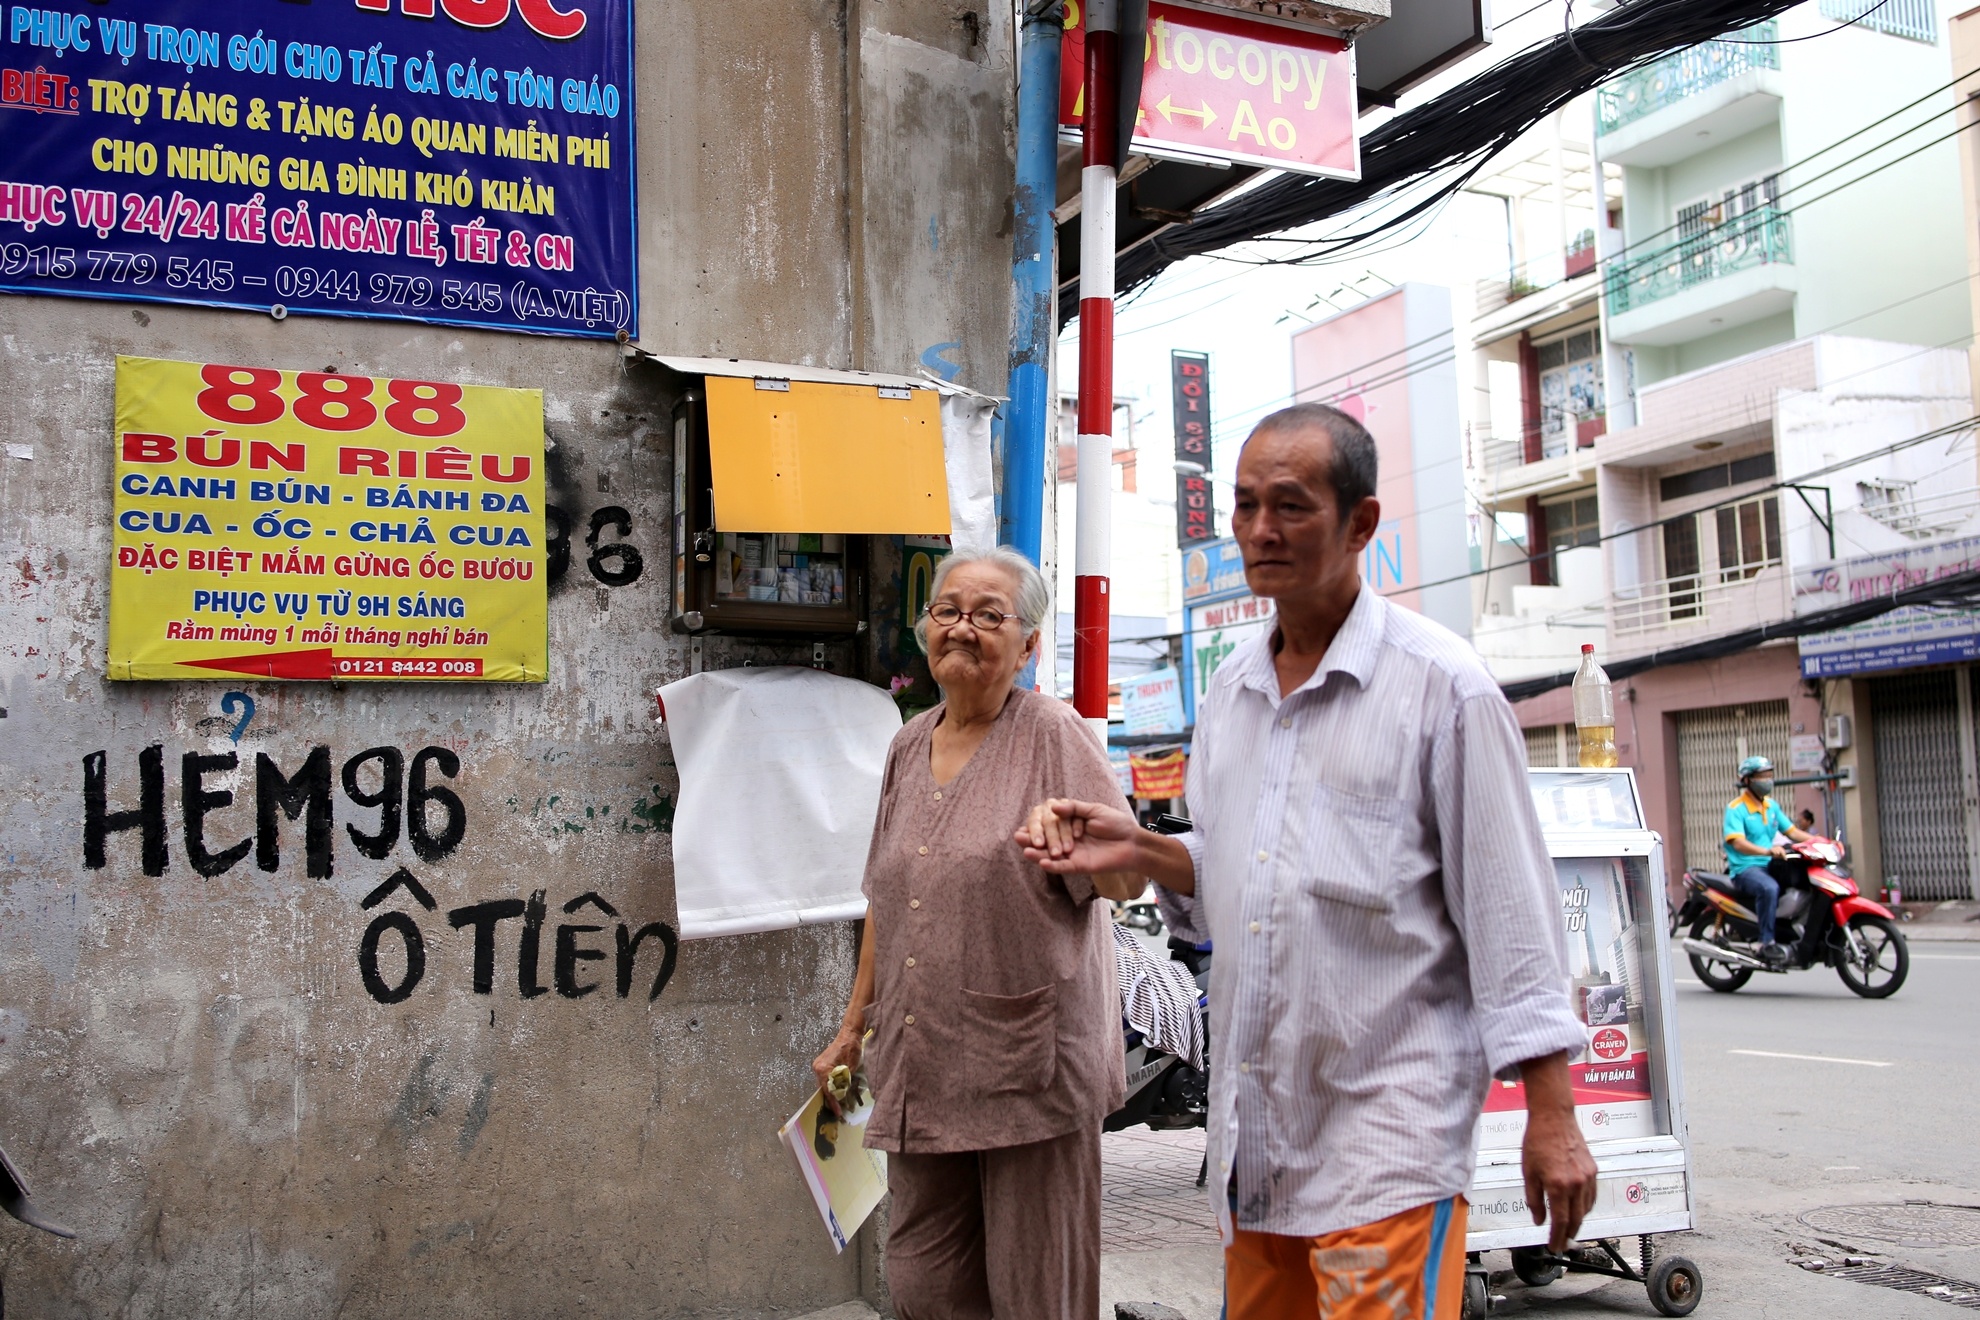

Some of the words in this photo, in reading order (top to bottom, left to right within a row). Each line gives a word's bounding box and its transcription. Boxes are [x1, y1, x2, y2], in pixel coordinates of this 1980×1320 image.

[11, 6, 91, 58] PHỤC
[98, 17, 137, 66] VỤ
[144, 24, 220, 74] TRỌN
[228, 29, 277, 75] GÓI
[285, 41, 342, 82] CHO
[349, 42, 398, 89] TẤT
[404, 50, 441, 95] CẢ
[446, 58, 498, 103] CÁC
[504, 67, 554, 110] TÔN
[561, 75, 620, 118] GIÁO
[1, 66, 79, 113] BIỆT:
[88, 79, 151, 125] TRỢ
[158, 82, 237, 128] TÁNG
[246, 97, 271, 131] &
[278, 97, 354, 142] TẶNG
[362, 104, 403, 145] ÁO
[411, 117, 486, 158] QUAN
[494, 120, 559, 164] MIỄN
[567, 133, 610, 169] PHÍ
[92, 138, 158, 176] CHO
[167, 144, 270, 188] NHỮNG
[279, 157, 330, 193] GIA
[336, 157, 407, 201] ĐÌNH
[415, 169, 474, 208] KHÓ
[481, 176, 555, 216] KHĂN
[72, 188, 117, 239] VỤ
[121, 191, 219, 243] 24/24
[226, 192, 266, 243] KỂ
[271, 200, 315, 248] CẢ
[321, 208, 401, 256] NGÀY
[406, 209, 446, 268] LỄ,
[452, 216, 501, 264] TẾT
[505, 230, 531, 268] &
[534, 234, 574, 271] CN
[0, 242, 77, 279] 915
[87, 250, 157, 285] 779
[166, 256, 235, 292] 545
[275, 265, 360, 302] 0944
[370, 273, 434, 308] 979
[442, 280, 503, 313] 545
[511, 281, 630, 329] (A.VIỆT)
[196, 363, 467, 437] 888
[121, 430, 306, 473] BÚN
[337, 446, 531, 484] RIÊU
[120, 474, 236, 500] CANH
[250, 477, 330, 506] BÚN
[360, 481, 469, 512] BÁNH
[481, 490, 531, 514] ĐA
[118, 511, 213, 535] CUA
[251, 509, 312, 540] ỐC
[349, 515, 437, 545] CHẢ
[448, 526, 532, 548] CUA
[118, 545, 179, 575] ĐẶC
[188, 546, 253, 579] BIỆT
[261, 545, 326, 577] MẮM
[333, 550, 410, 579] GỪNG
[418, 550, 456, 579] ỐC
[463, 558, 534, 582] BƯƠU
[193, 590, 267, 620] PHỤC
[274, 592, 309, 620] VỤ
[317, 591, 352, 616] TỪ
[357, 597, 388, 618] 9H
[396, 589, 465, 619] SÁNG
[166, 619, 215, 641] Rằm
[220, 622, 278, 646] mùng
[285, 625, 295, 642] 1
[302, 621, 342, 644] mỗi
[344, 622, 401, 648] tháng
[405, 622, 448, 648] nghỉ
[453, 627, 488, 646] bán
[339, 661, 385, 674] 0121
[391, 661, 437, 675] 8442
[442, 661, 476, 674] 008
[1562, 884, 1590, 908] MỚI
[358, 867, 437, 1004] Ô
[1564, 907, 1588, 932] TỚI
[1594, 1040, 1625, 1050] CRAVEN
[1607, 1049, 1614, 1057] A
[1126, 1062, 1162, 1087] AMAHA
[1584, 1068, 1600, 1083] VẪN
[1600, 1071, 1608, 1083] VỊ
[1608, 1068, 1624, 1083] ĐẬM
[1485, 1122, 1507, 1133] THUỐC
[1479, 1200, 1508, 1215] THUỐC
